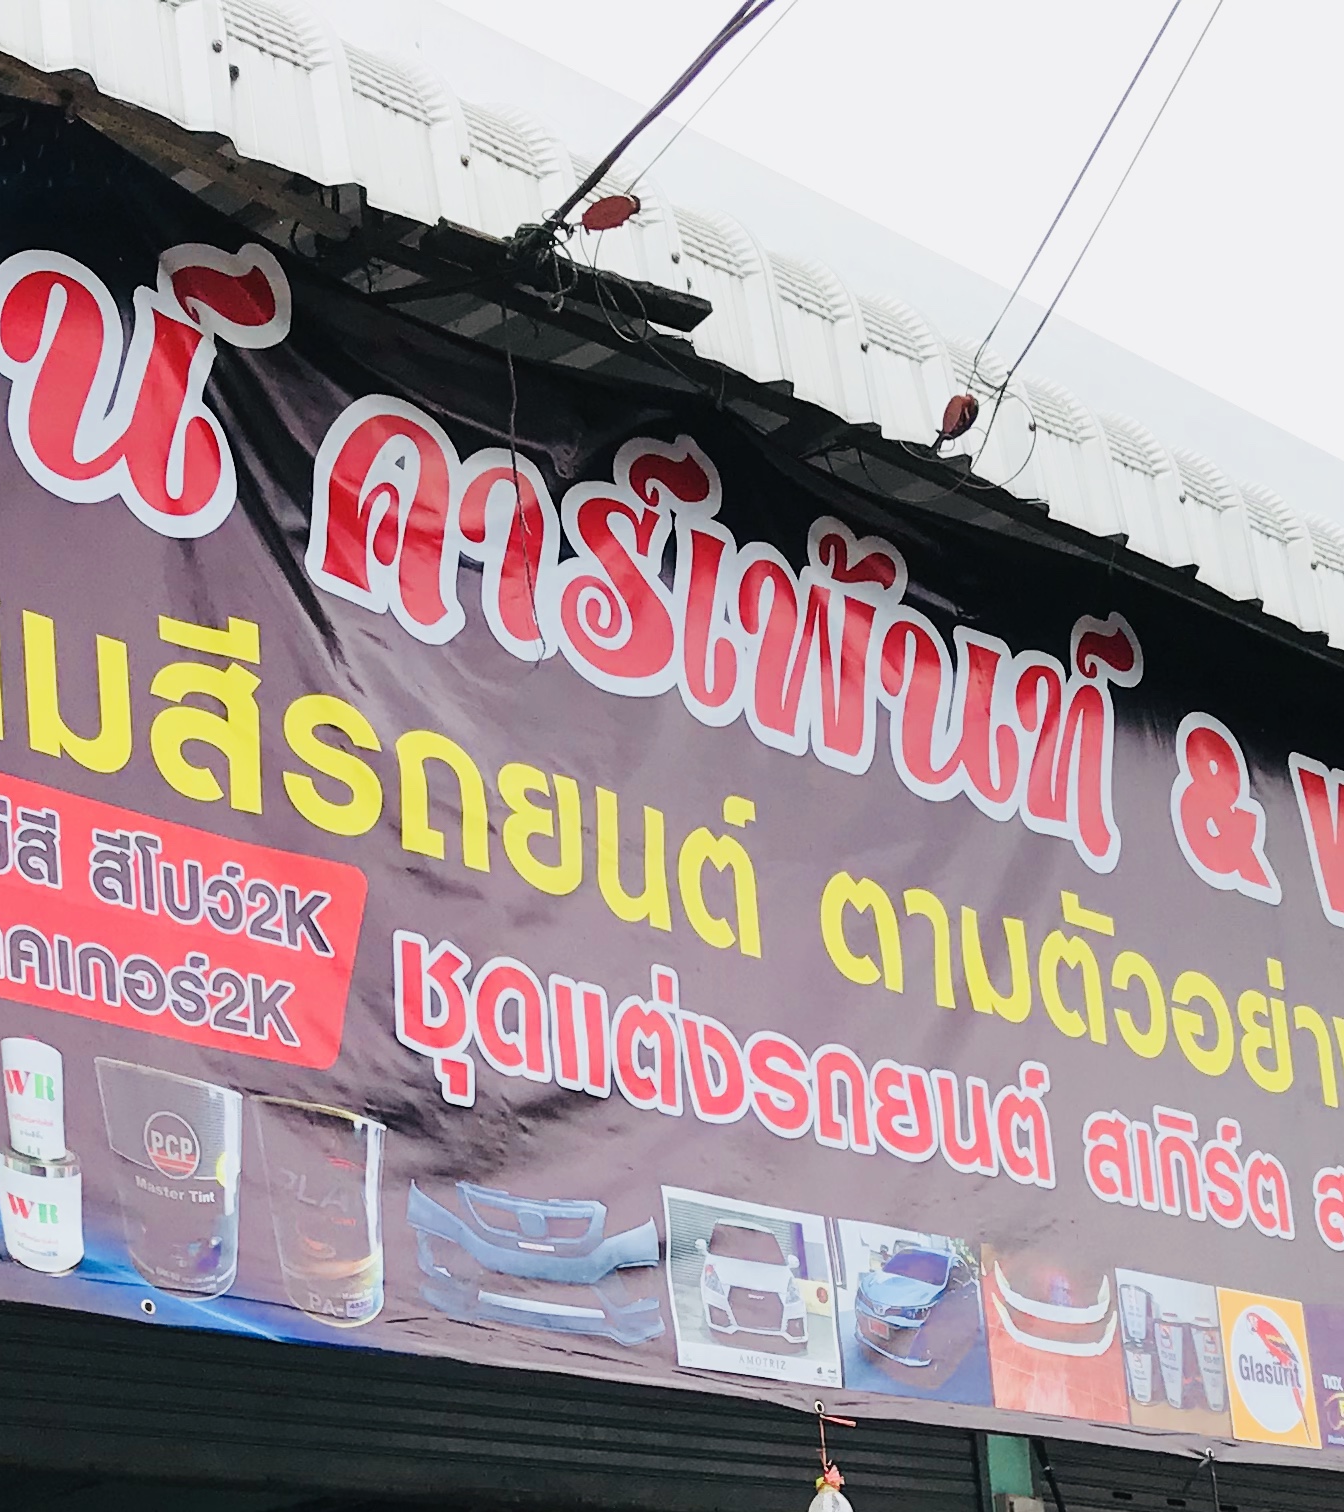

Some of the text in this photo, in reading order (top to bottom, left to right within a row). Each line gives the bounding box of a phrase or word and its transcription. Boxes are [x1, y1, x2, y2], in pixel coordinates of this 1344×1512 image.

[304, 394, 1144, 874] คาร์เพ้นท์
[1171, 711, 1283, 905] &
[5, 1069, 56, 1102] WR
[393, 929, 1056, 1190] ชุดแต่งรถยนต์
[1084, 1104, 1296, 1242] สเกิร์ต
[150, 1129, 194, 1162] PCP
[135, 1175, 216, 1203] Master Tint
[7, 1191, 60, 1225] WR
